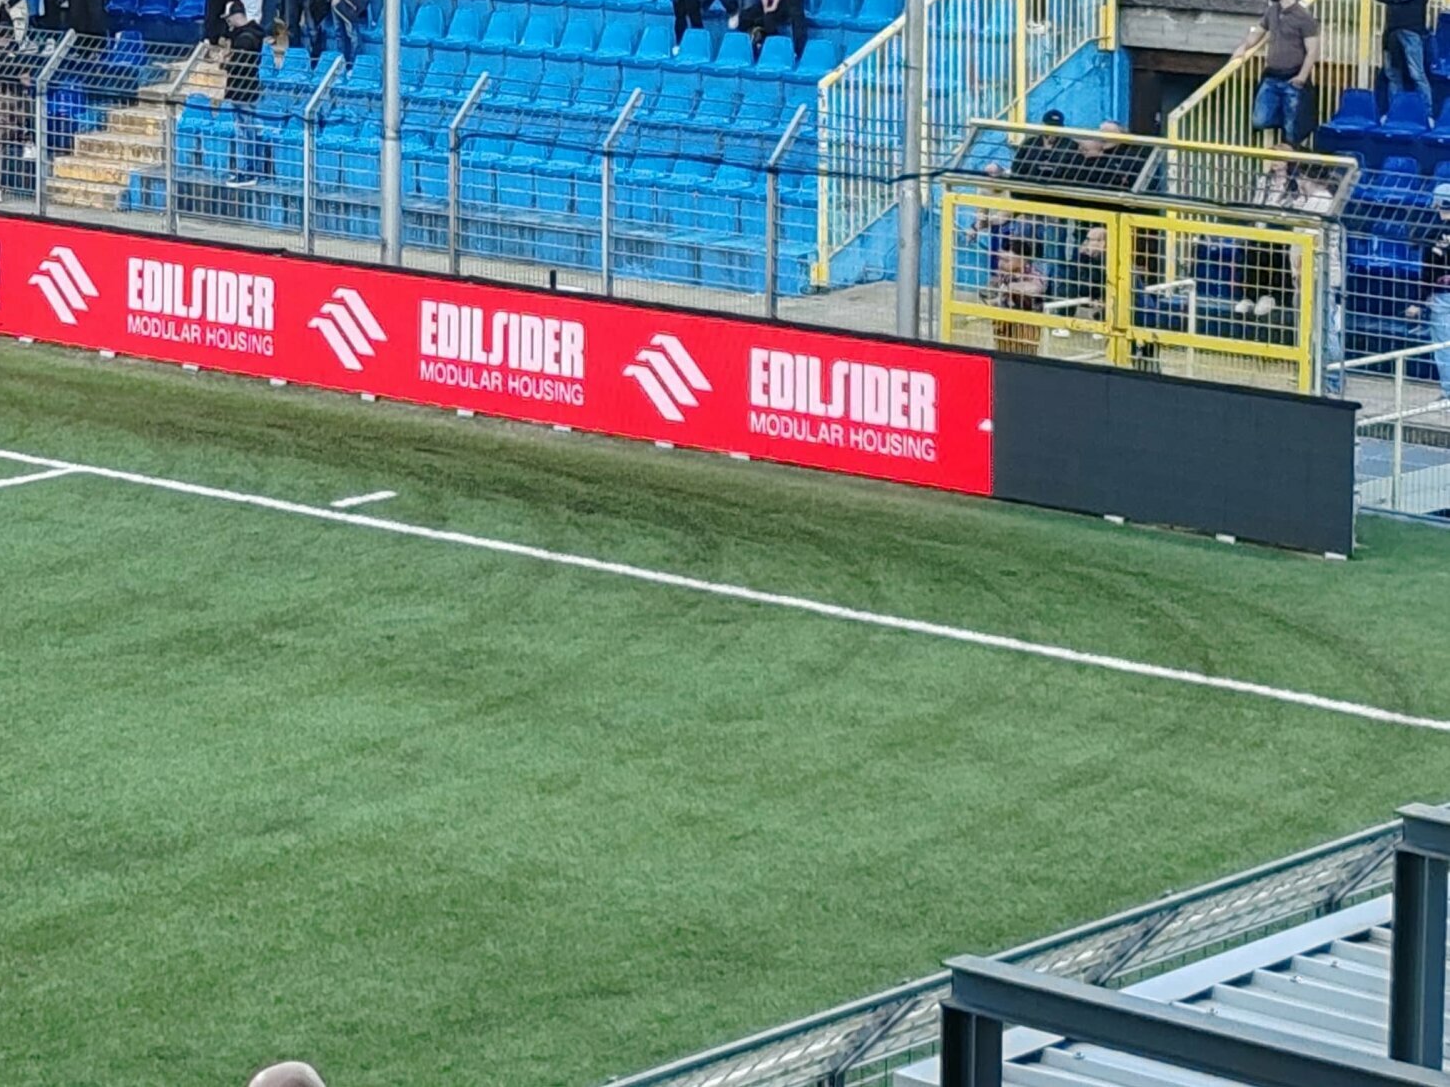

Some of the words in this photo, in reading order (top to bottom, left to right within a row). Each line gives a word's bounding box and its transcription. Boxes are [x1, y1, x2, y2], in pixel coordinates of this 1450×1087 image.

[128, 258, 274, 330] EDILSIDER
[128, 314, 201, 346] MODULAR
[206, 327, 273, 356] HOUSING
[421, 300, 584, 378] EDILSIDER
[420, 360, 503, 391] MODULAR
[507, 375, 584, 406] HOUSING
[750, 348, 936, 432] EDILSIDER
[750, 411, 844, 446] MODULAR
[849, 429, 935, 461] HOUSING
